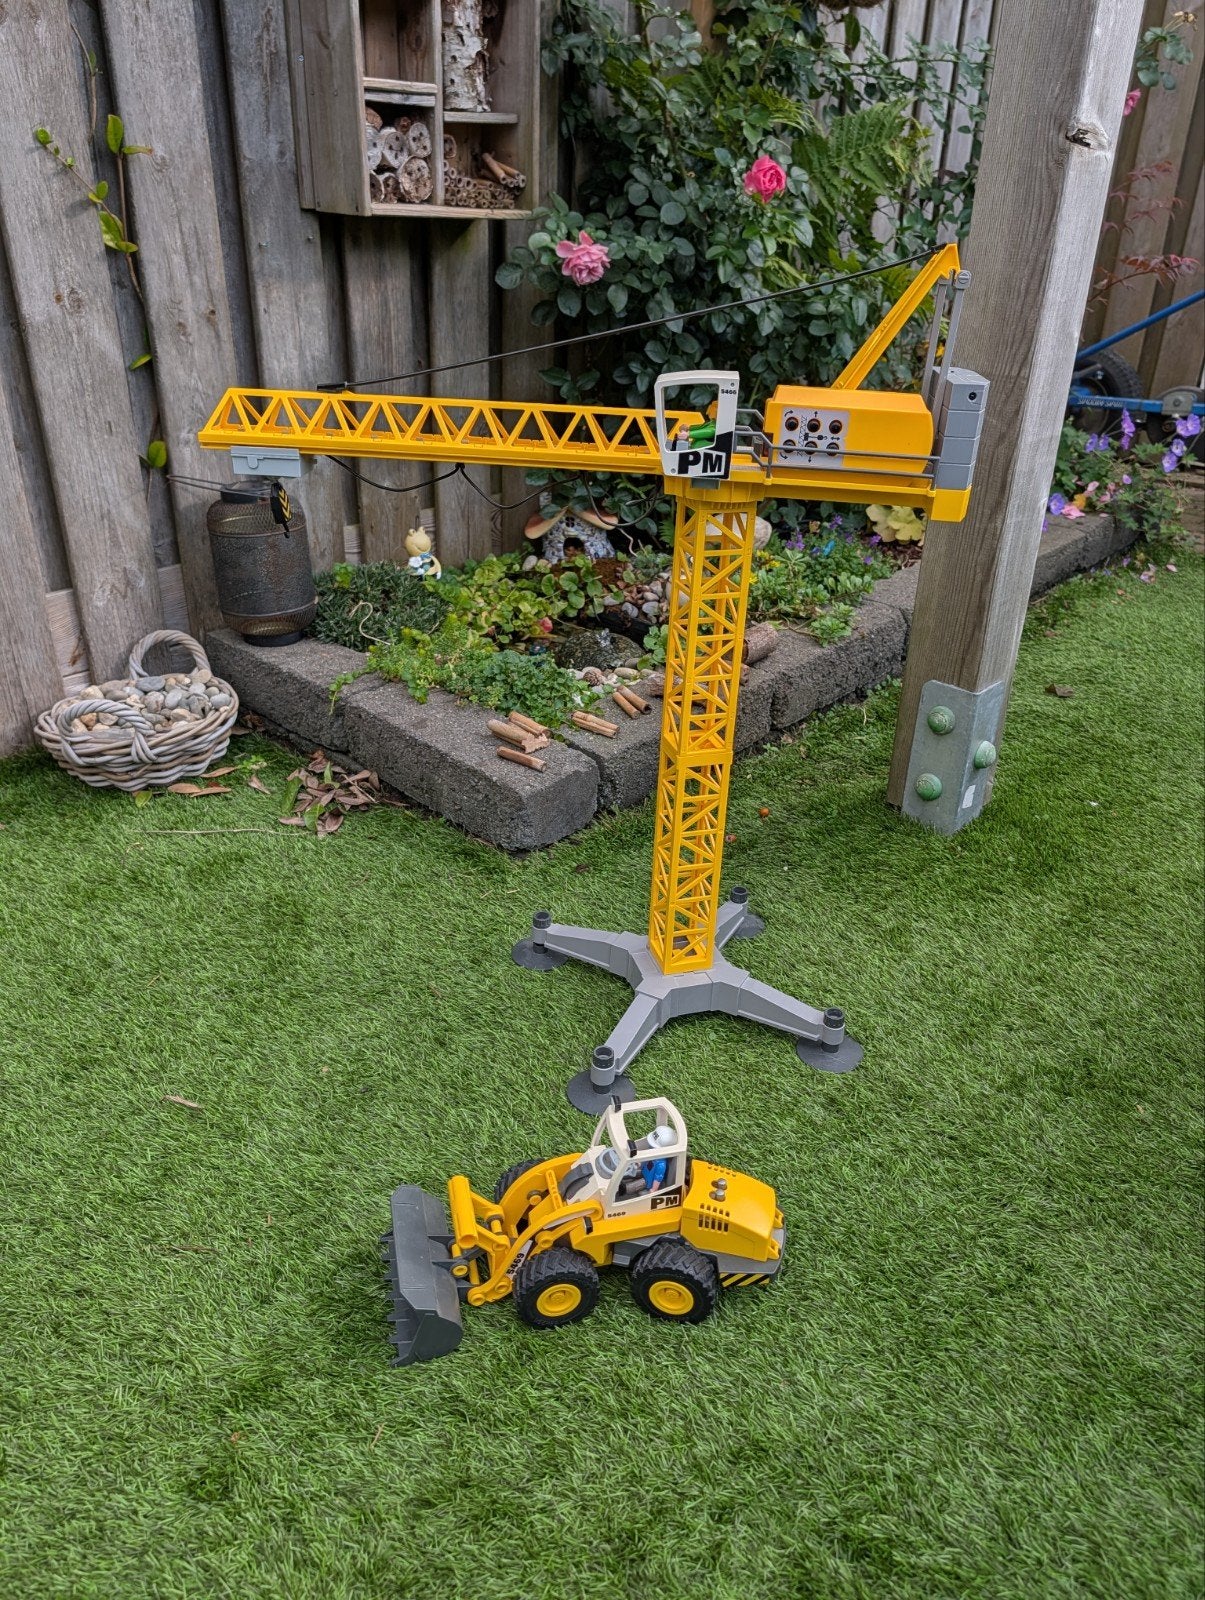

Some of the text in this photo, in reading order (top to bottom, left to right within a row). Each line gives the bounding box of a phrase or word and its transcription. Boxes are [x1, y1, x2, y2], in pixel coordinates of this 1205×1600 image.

[677, 451, 723, 475] PM
[651, 1196, 678, 1210] PM
[506, 1252, 525, 1274] 5469
